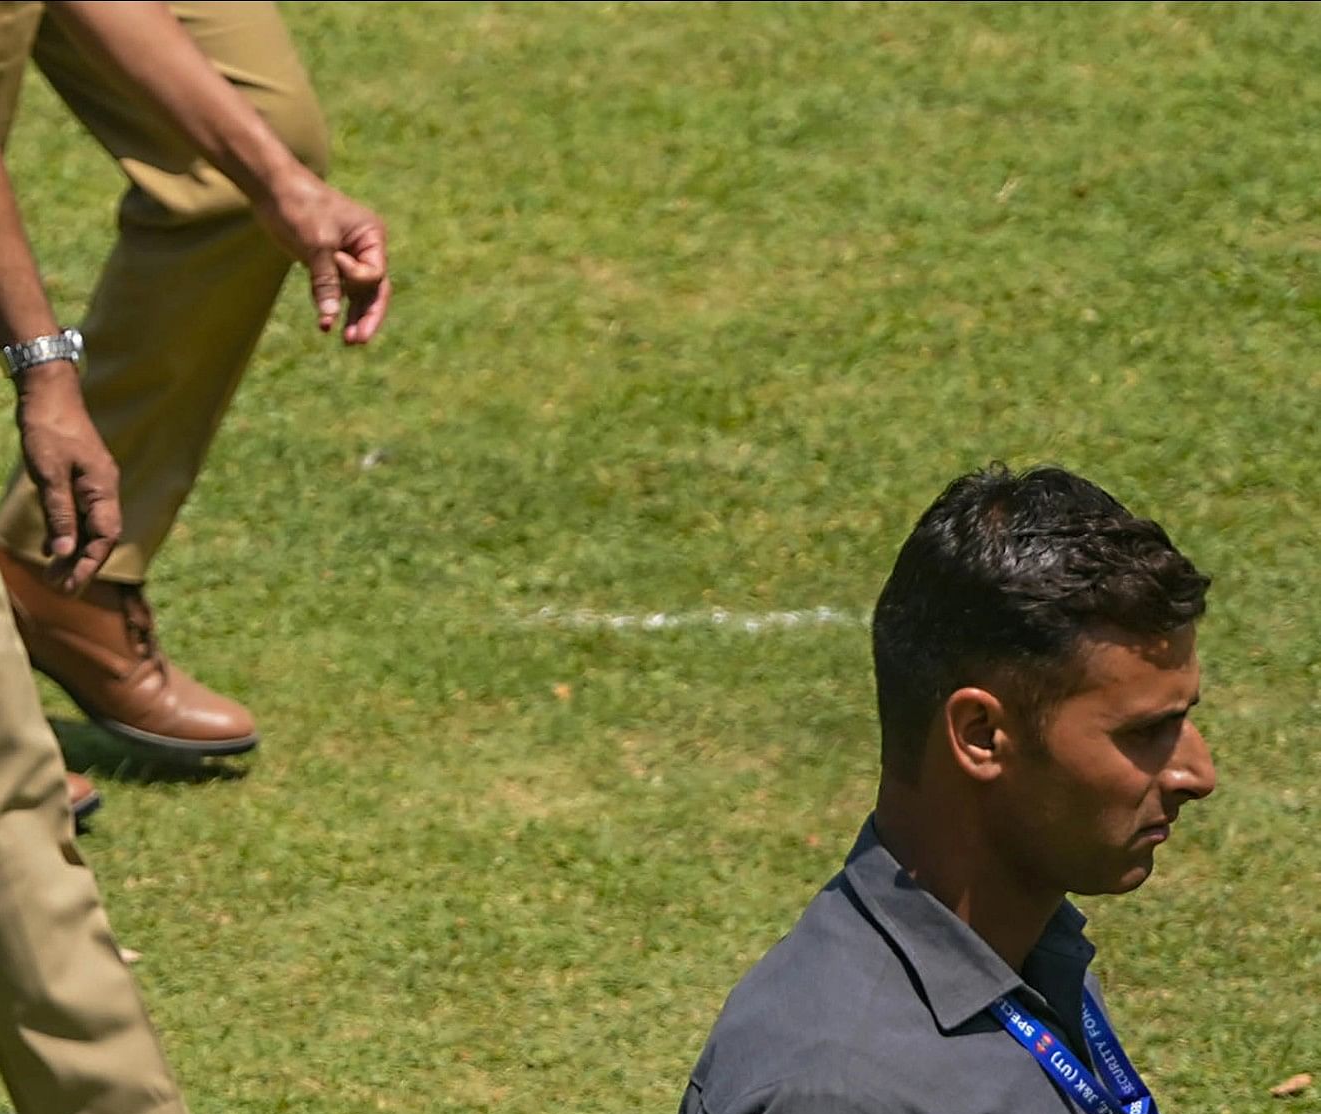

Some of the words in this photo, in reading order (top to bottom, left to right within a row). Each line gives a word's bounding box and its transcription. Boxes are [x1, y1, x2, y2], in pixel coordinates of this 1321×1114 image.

[1050, 1050, 1078, 1082] (UT)
[1094, 1041, 1135, 1095] SECURITY
[1075, 1077, 1099, 1104] J&K
